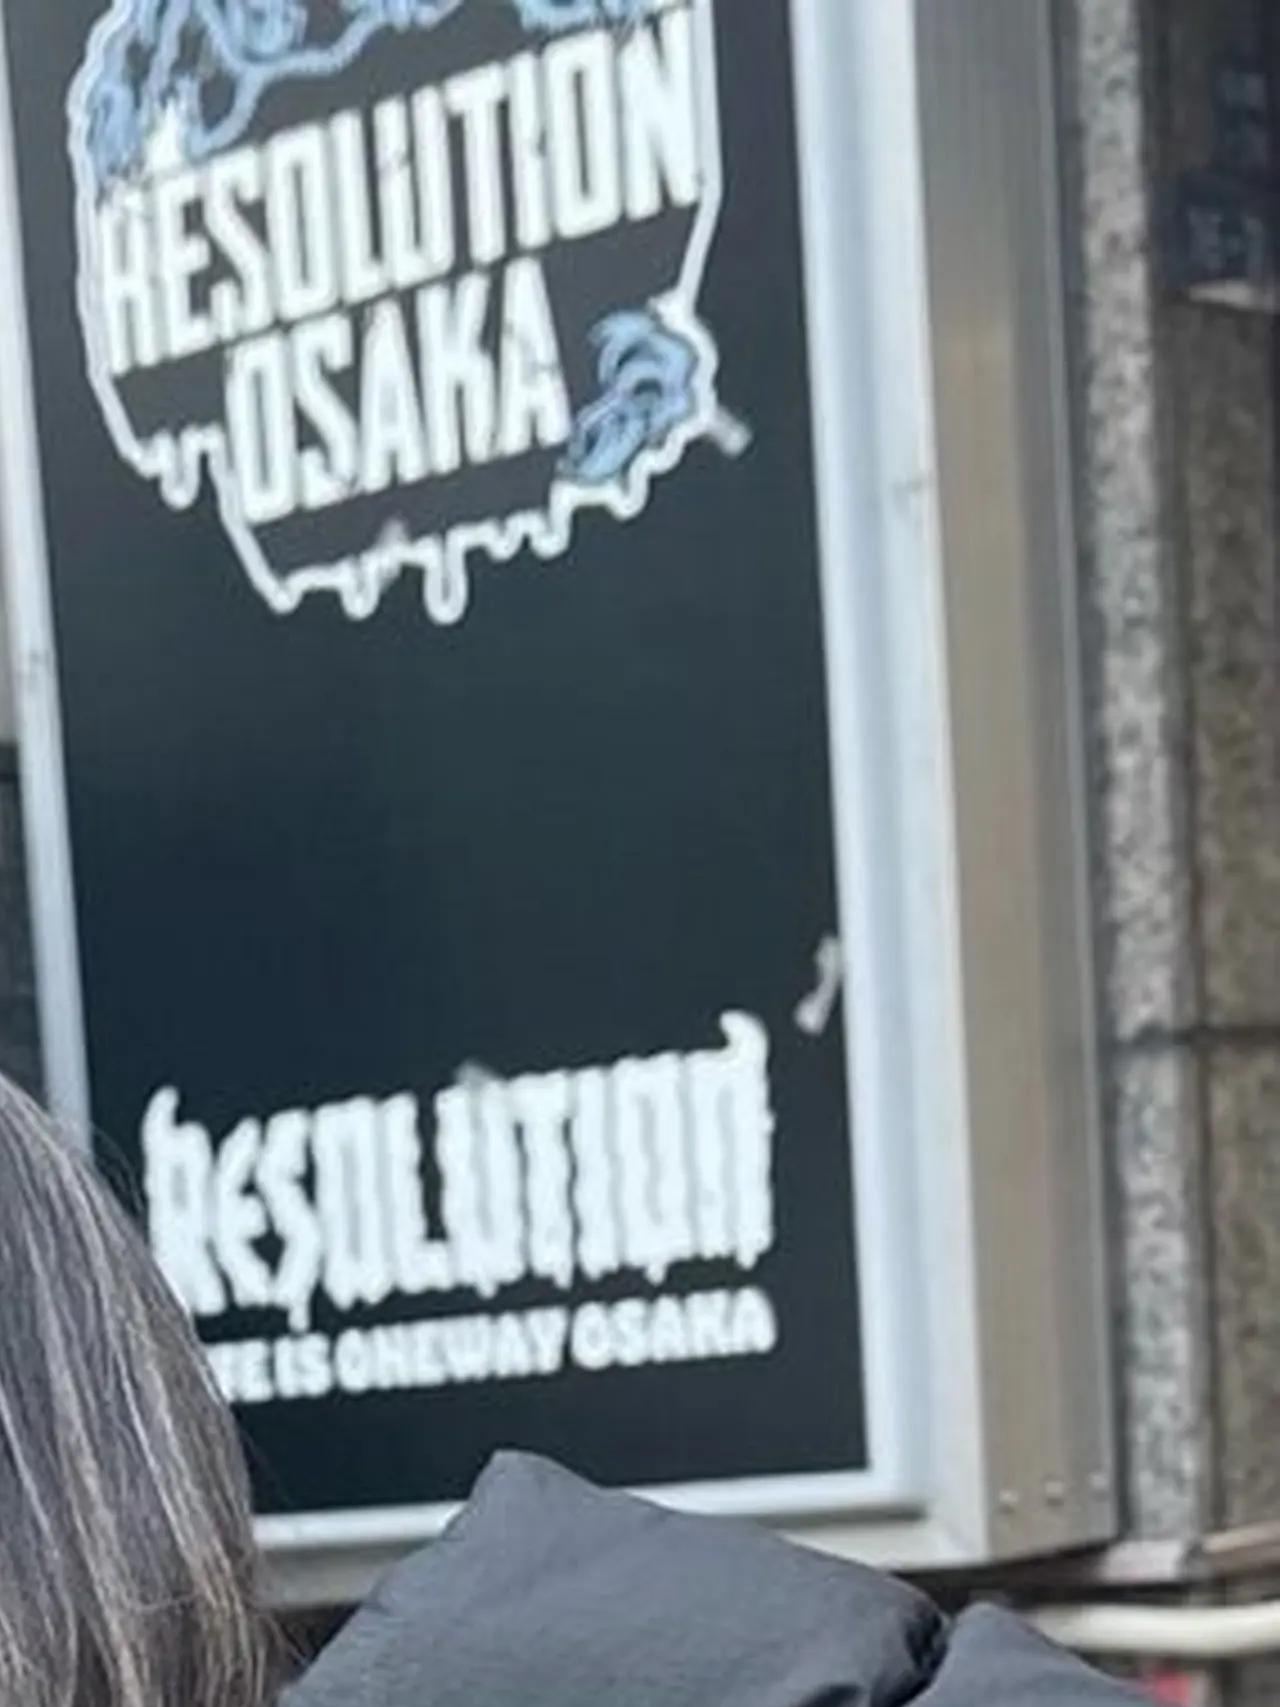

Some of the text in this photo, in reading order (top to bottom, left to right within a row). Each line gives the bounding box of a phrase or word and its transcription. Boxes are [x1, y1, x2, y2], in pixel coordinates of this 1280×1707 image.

[93, 8, 704, 377] RESOLUTION
[223, 256, 573, 526] OSAKA
[274, 1333, 332, 1398] IS
[570, 1286, 777, 1370] OSAKA
